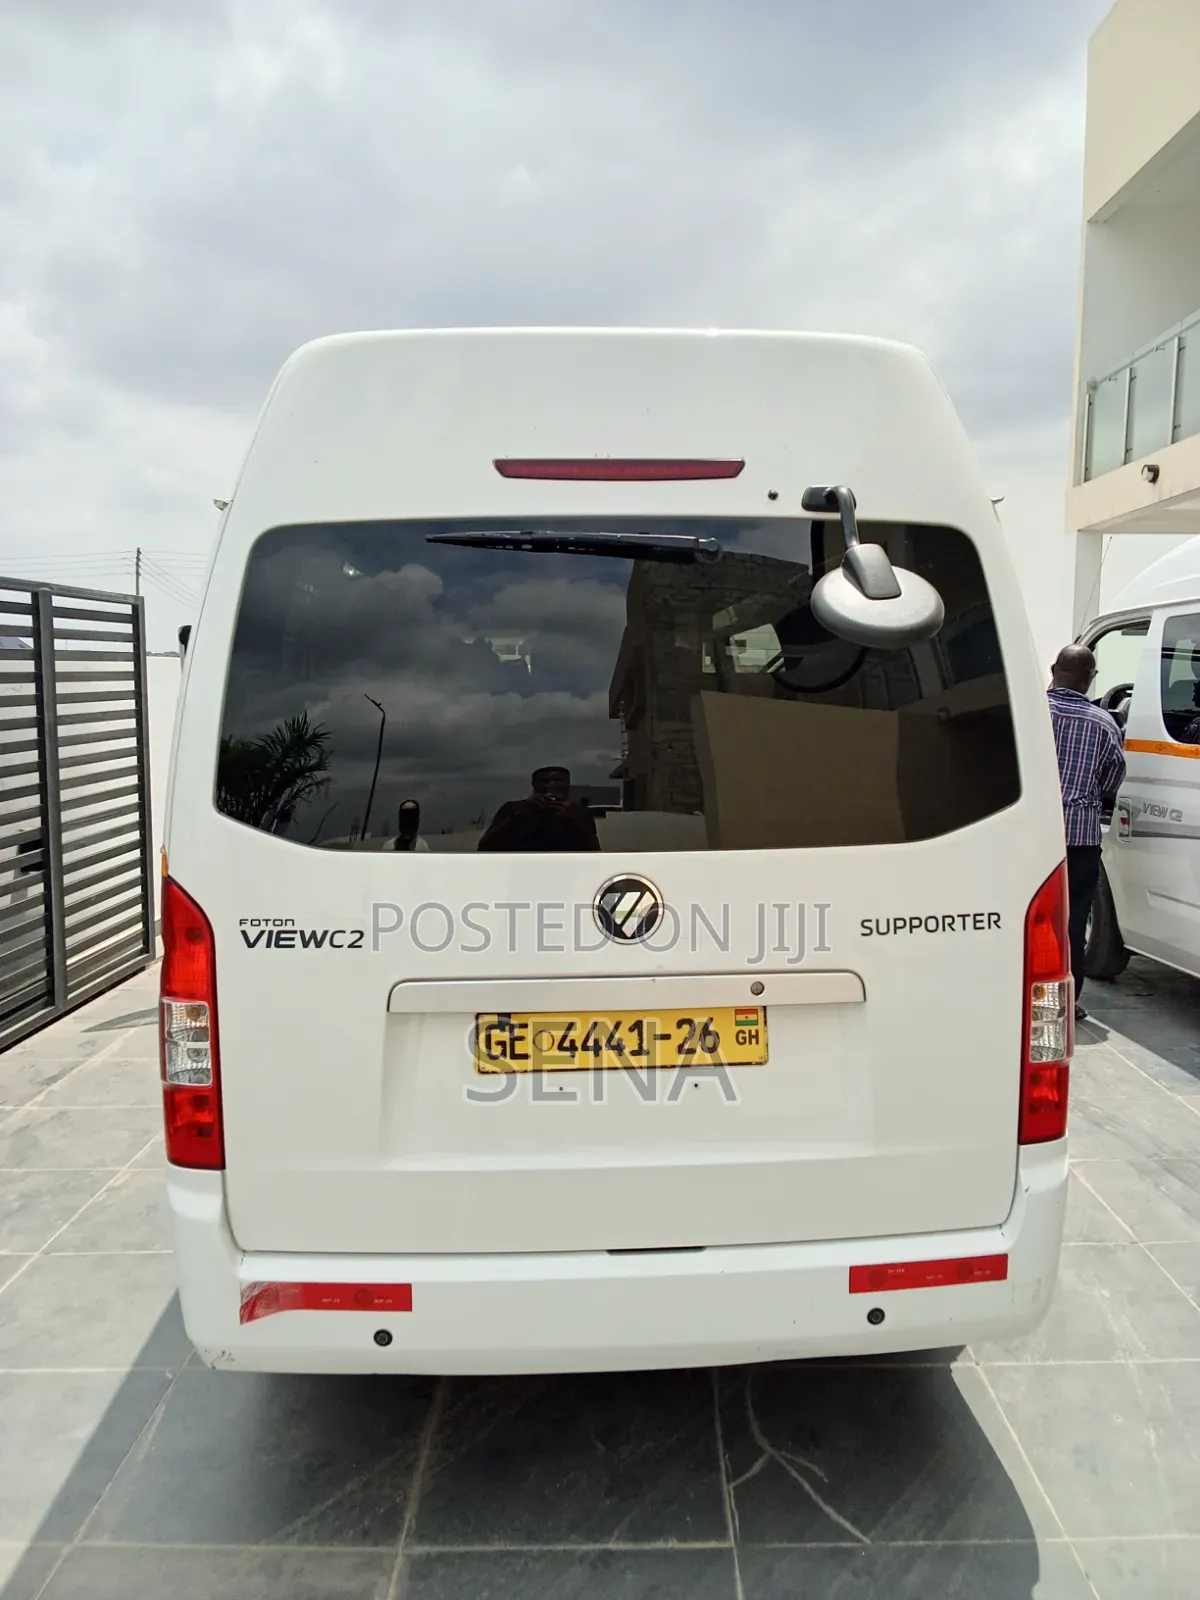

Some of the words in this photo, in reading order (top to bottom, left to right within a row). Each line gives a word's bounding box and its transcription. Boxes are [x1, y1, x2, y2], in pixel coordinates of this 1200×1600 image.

[239, 918, 295, 927] FOTON
[860, 911, 1002, 937] SUPPORTER
[556, 1017, 720, 1058] 4441-26
[734, 1028, 760, 1046] GH
